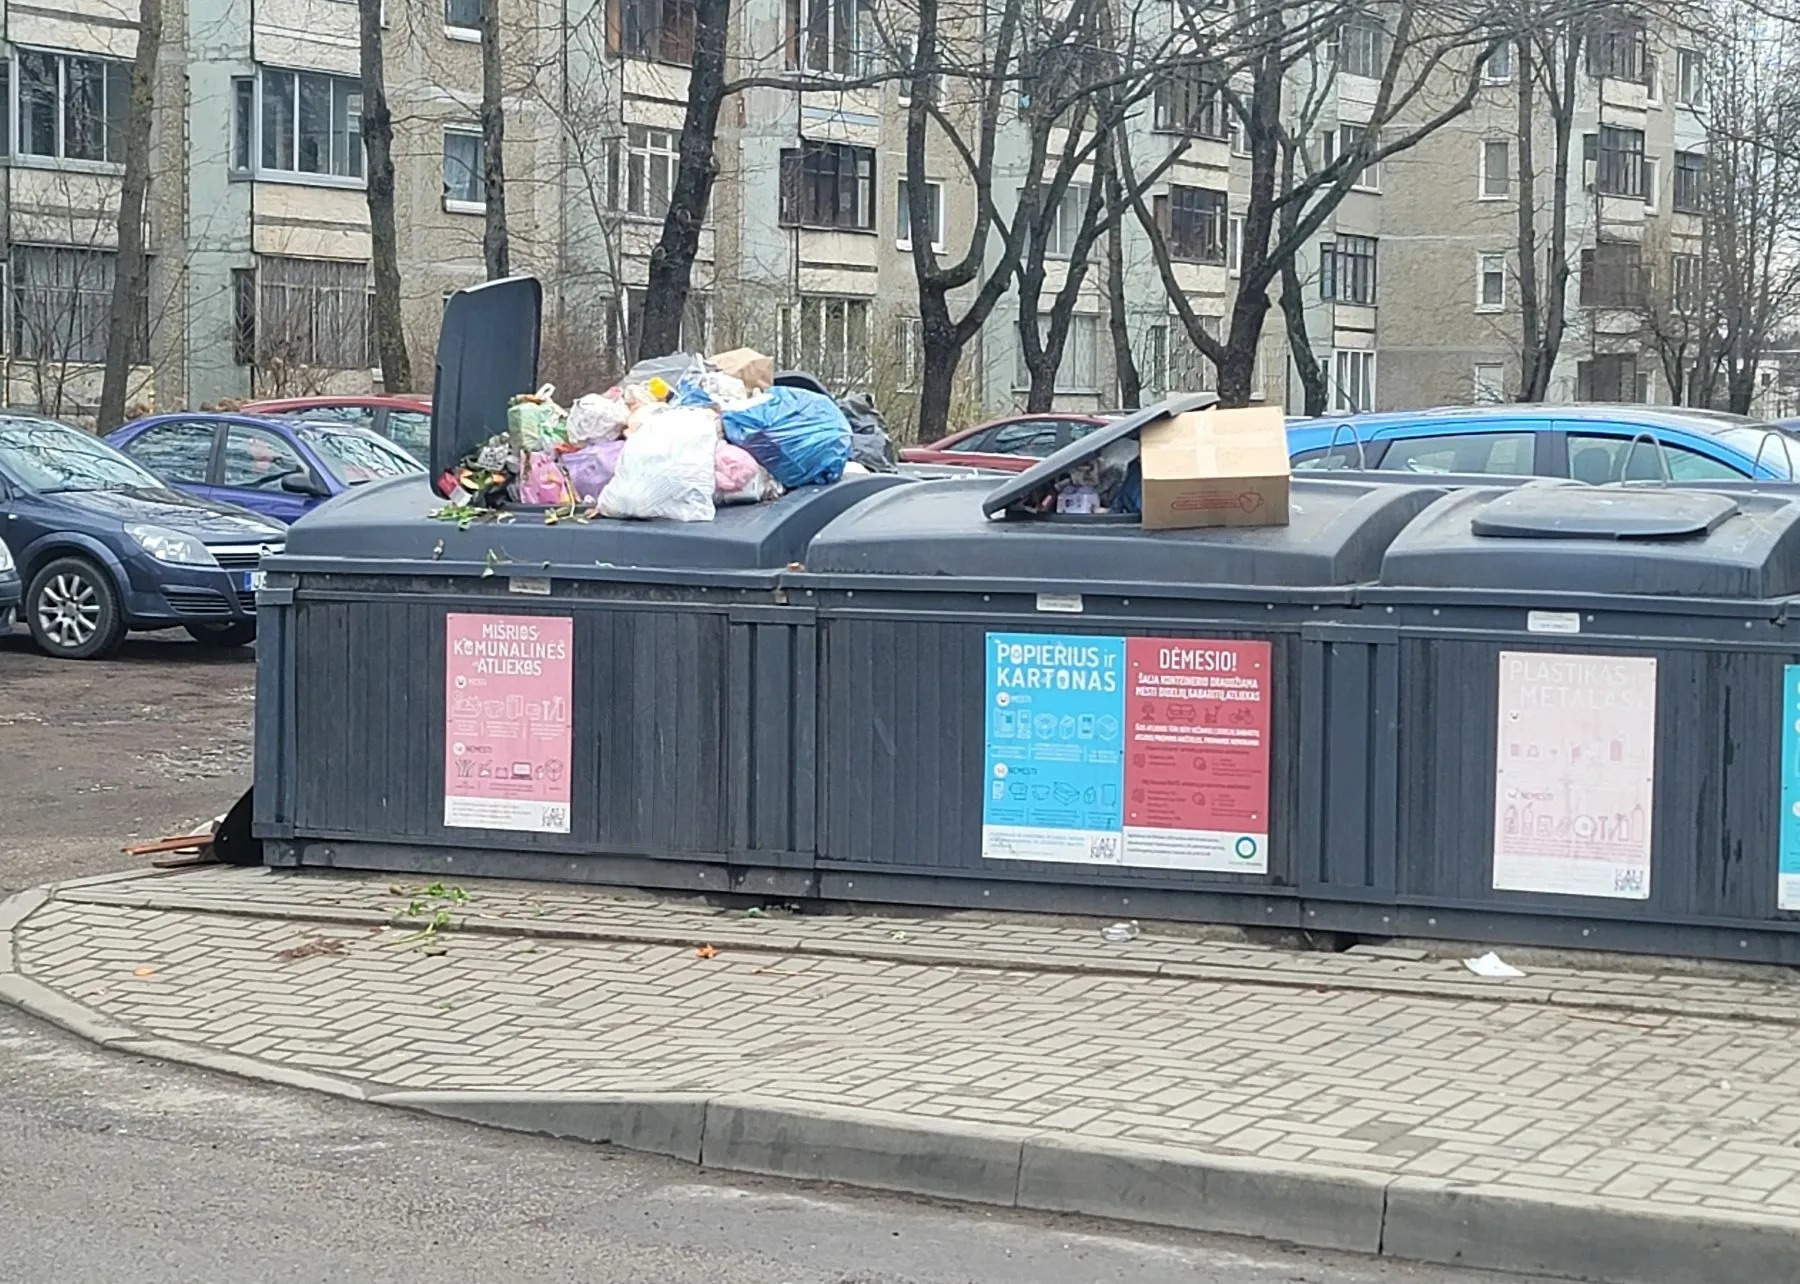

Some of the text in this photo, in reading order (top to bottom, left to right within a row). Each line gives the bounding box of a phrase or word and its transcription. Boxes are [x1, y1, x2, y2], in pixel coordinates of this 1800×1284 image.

[482, 620, 537, 640] MIŠRIOS
[477, 658, 542, 676] ATLIEKOS
[996, 643, 1117, 668] POPIERIUS ir
[1159, 646, 1237, 672] DĖMESIO!
[996, 666, 1117, 692] KARTONAS
[1510, 660, 1626, 686] PLASTIKAS
[1520, 685, 1634, 711] METALAS
